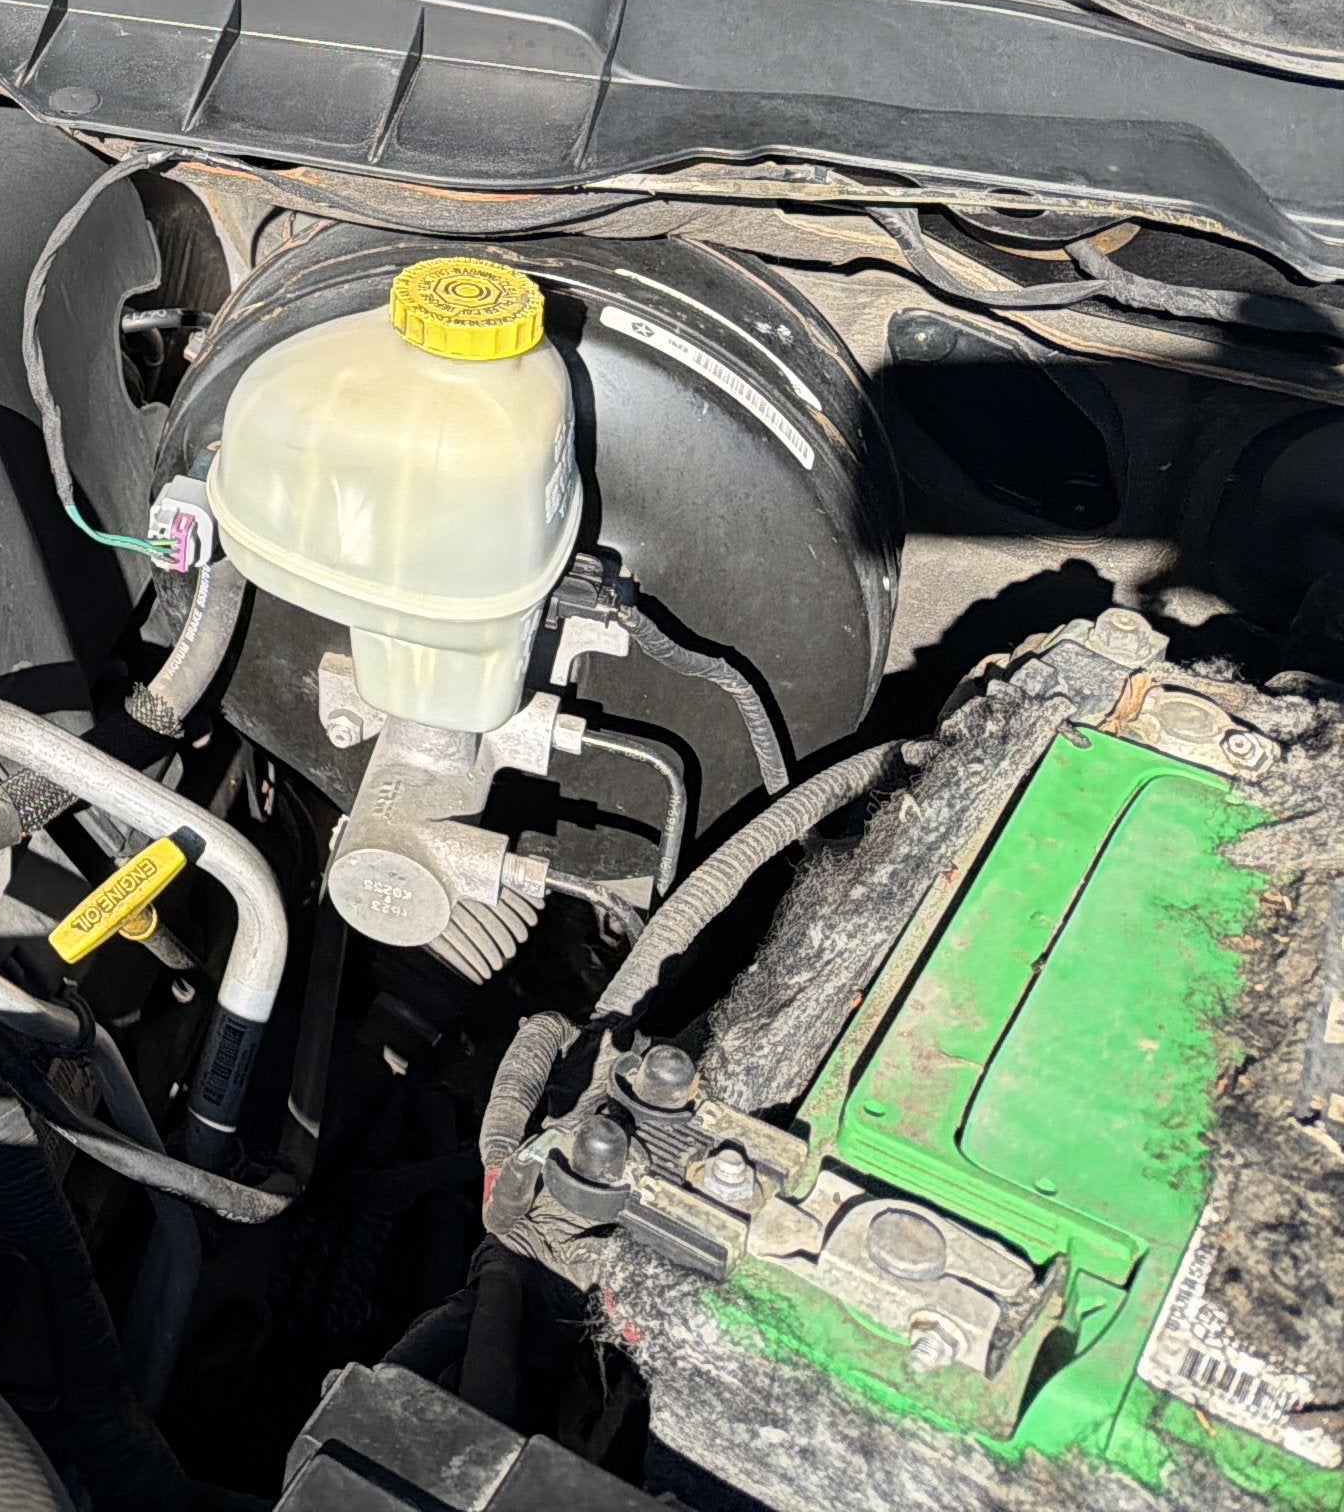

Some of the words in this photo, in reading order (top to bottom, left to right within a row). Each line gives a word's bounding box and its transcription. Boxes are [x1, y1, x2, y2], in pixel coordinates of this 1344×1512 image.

[162, 644, 190, 680] VACUUM
[185, 609, 203, 643] BRAKE
[97, 858, 157, 913] ENGINE
[71, 906, 102, 933] OIL
